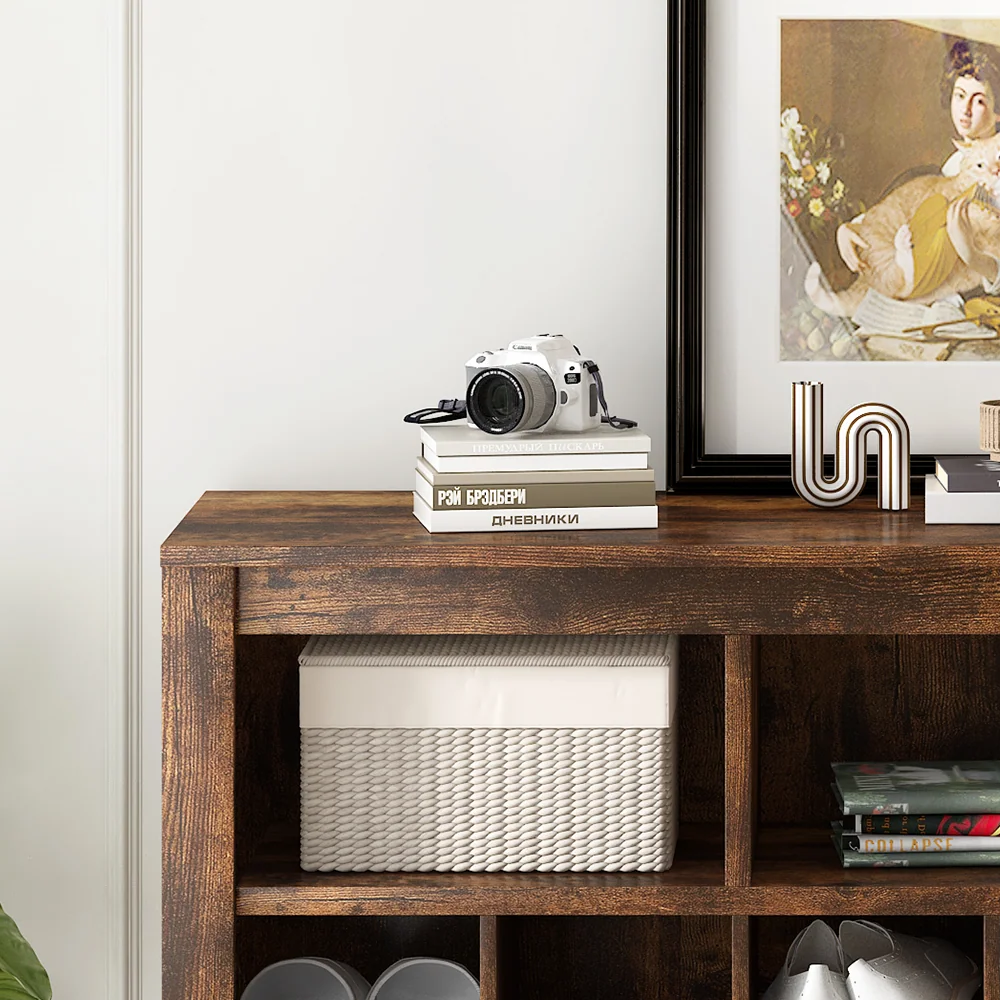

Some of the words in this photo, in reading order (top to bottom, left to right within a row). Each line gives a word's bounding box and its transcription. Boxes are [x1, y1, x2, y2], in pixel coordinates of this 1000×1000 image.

[437, 486, 461, 506] РЭЙ
[466, 488, 526, 506] БРЭДБЕРИ
[491, 514, 579, 526] ДНЕВНИКИ
[864, 837, 954, 853] COLLAPSE
